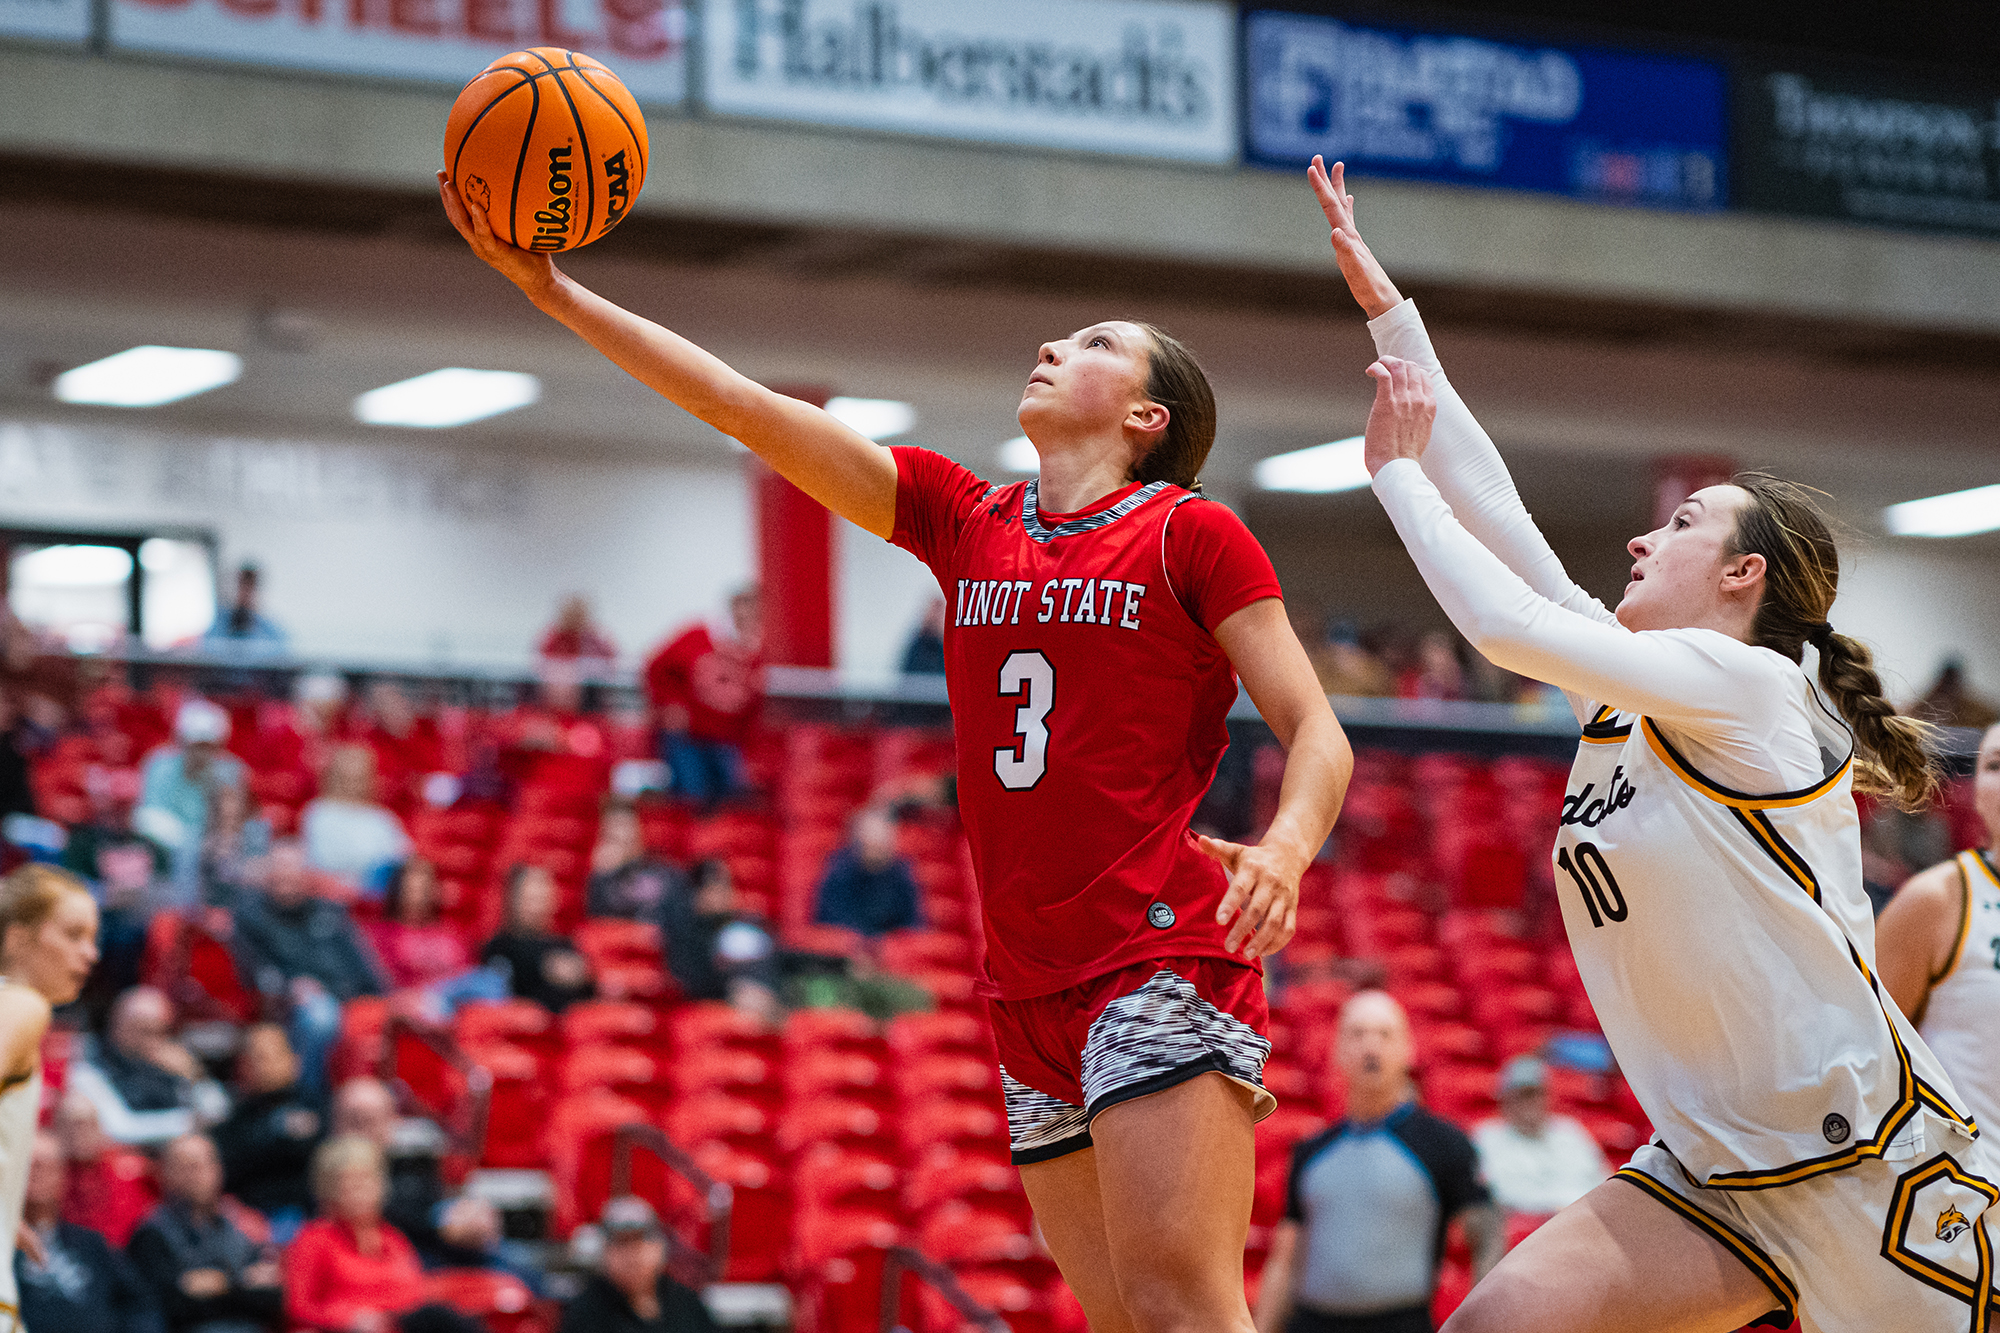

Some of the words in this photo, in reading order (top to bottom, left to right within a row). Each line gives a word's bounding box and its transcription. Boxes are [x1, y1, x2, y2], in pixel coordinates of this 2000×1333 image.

[529, 145, 573, 250] Wilson
[1037, 577, 1146, 631] STATE
[993, 649, 1057, 792] 3
[1557, 842, 1629, 928] 10
